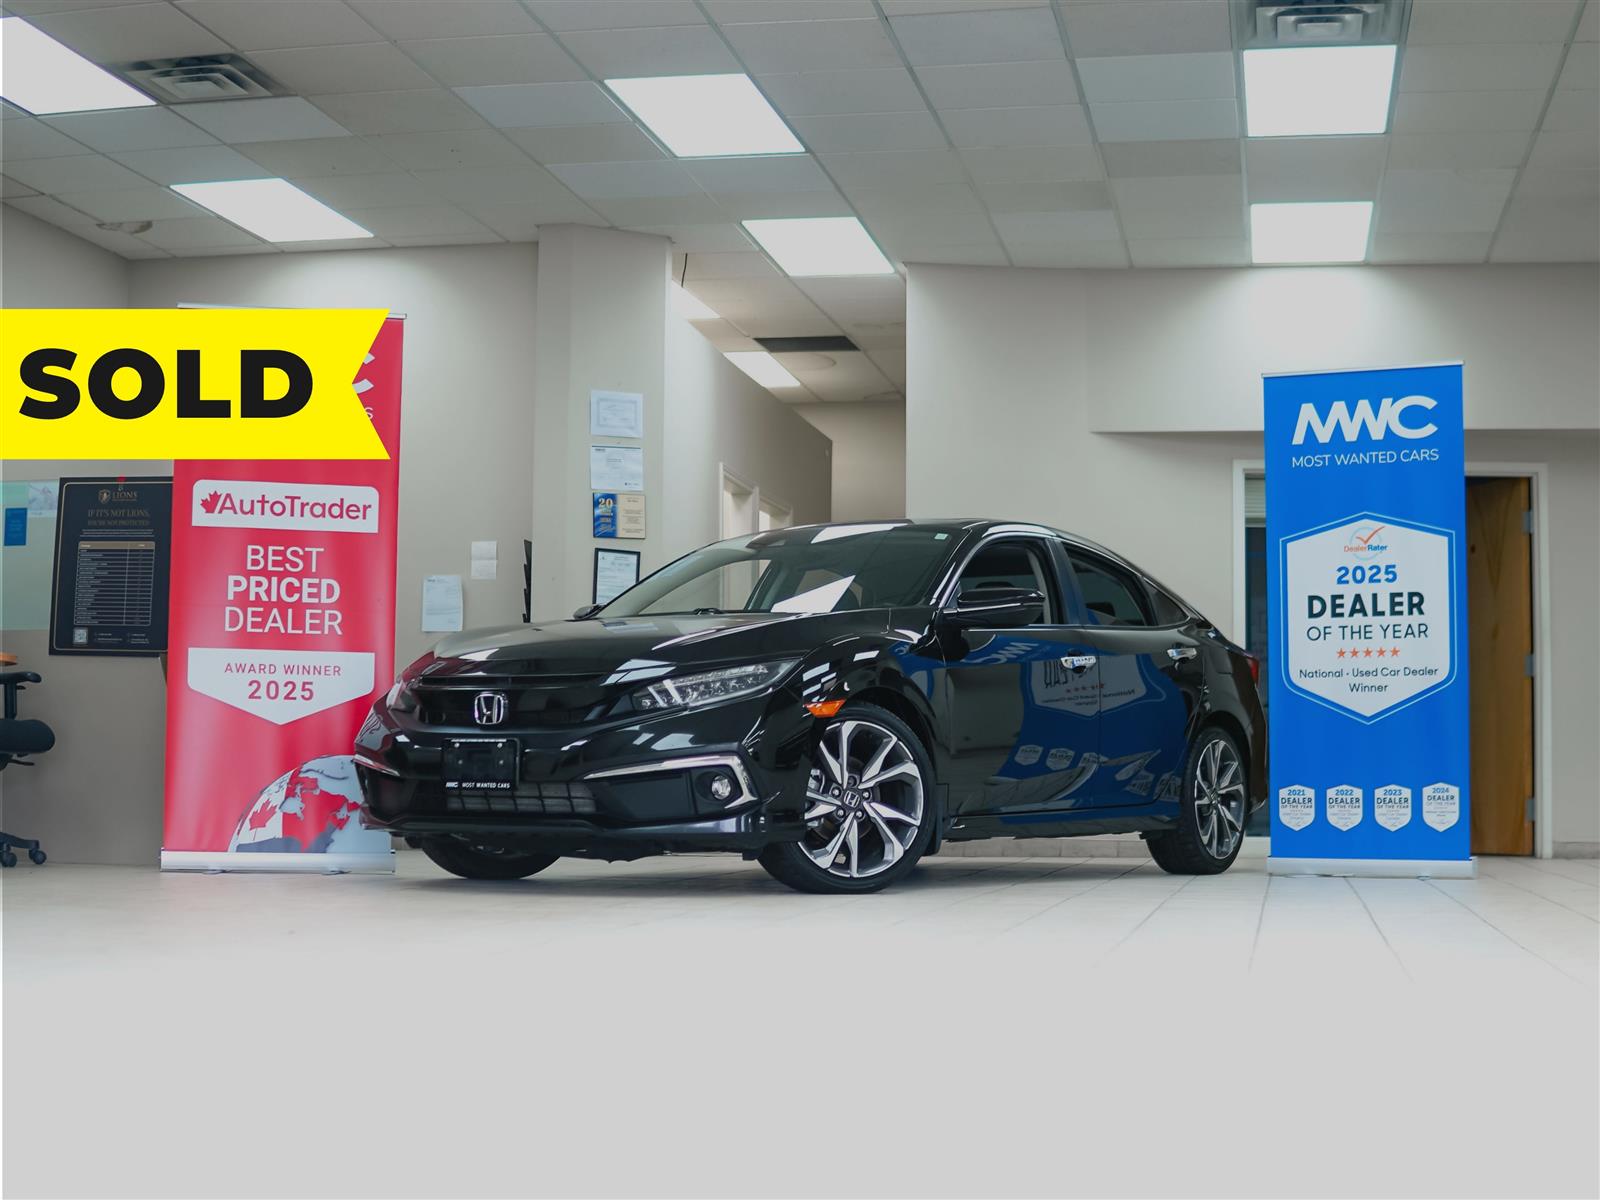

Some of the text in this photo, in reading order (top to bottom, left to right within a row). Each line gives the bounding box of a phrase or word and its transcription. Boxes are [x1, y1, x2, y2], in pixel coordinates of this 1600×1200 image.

[1292, 395, 1438, 445] MWC
[1292, 449, 1440, 468] MOST WANTED CARS
[218, 492, 372, 520] AutoTrader
[1344, 543, 1388, 552] DealerRater
[246, 544, 324, 573] BEST
[1336, 564, 1397, 585] 2025
[227, 575, 340, 604] PRICED
[1307, 591, 1424, 619] DEALER
[224, 606, 342, 635] DEALER
[1306, 623, 1428, 641] OF THE YEAR
[224, 663, 341, 676] AWARD WINNER
[1299, 666, 1439, 679] National Used Car Dealer
[248, 679, 314, 701] 2025
[1349, 683, 1388, 692] Winner
[1281, 797, 1313, 805] DEALER
[1328, 797, 1361, 805] DEALER
[1376, 797, 1409, 805] DEALER
